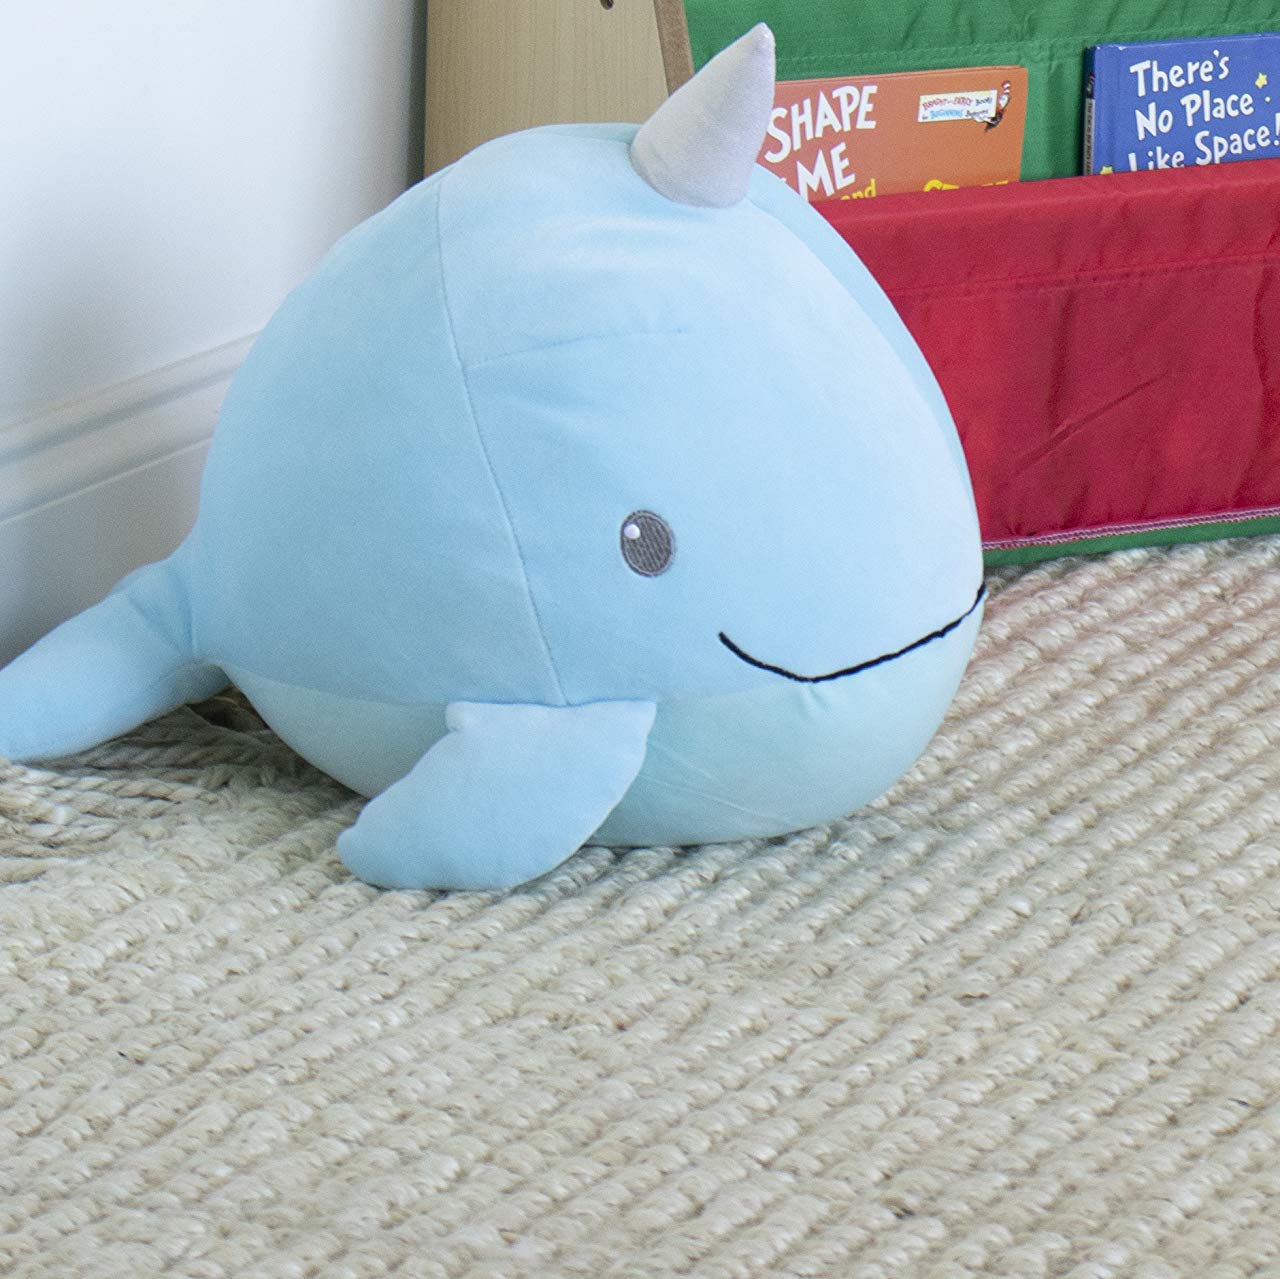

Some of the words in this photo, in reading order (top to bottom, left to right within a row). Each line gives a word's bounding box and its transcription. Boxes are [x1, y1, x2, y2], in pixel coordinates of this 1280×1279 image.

[1130, 50, 1230, 97] There's
[764, 85, 878, 163] SHAPE
[1135, 103, 1173, 140] No
[1180, 90, 1254, 127] Place
[797, 142, 855, 201] ME
